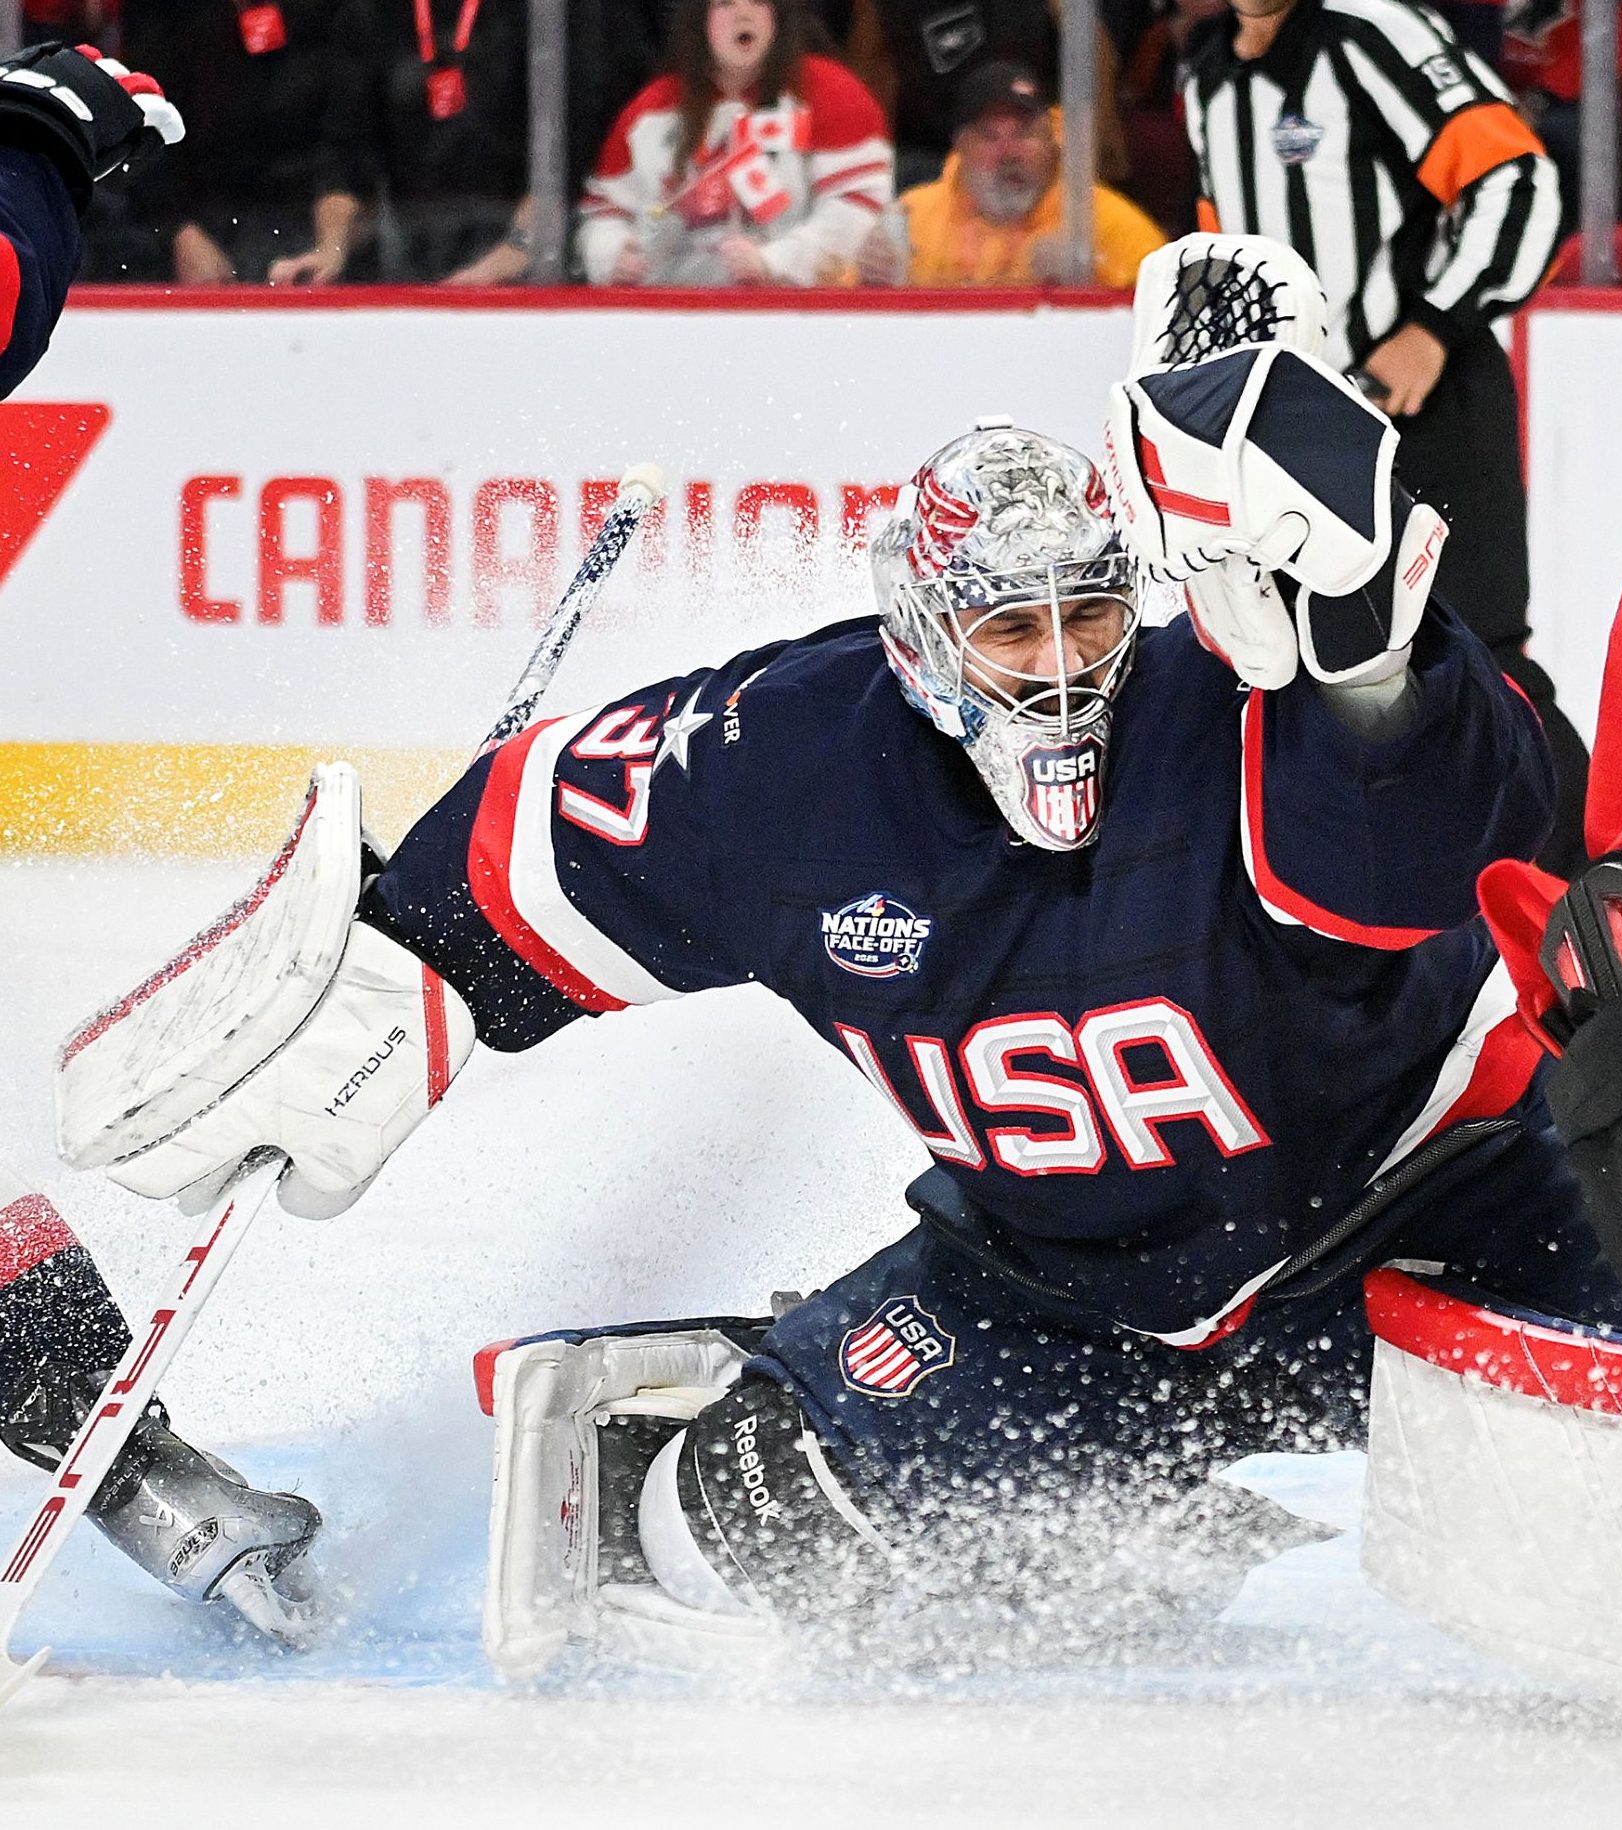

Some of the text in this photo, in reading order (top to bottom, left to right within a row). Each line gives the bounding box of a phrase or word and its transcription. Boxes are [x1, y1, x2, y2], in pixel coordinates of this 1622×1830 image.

[558, 691, 676, 847] 37
[1032, 749, 1096, 782] USA
[821, 912, 931, 939] NATIONS
[829, 933, 917, 954] FACE-OFF
[324, 1025, 407, 1117] HZRDUS
[835, 996, 1273, 1177] USA
[885, 1303, 943, 1362] USA
[1, 1200, 234, 1583] TRUE
[733, 1414, 782, 1527] Reebok
